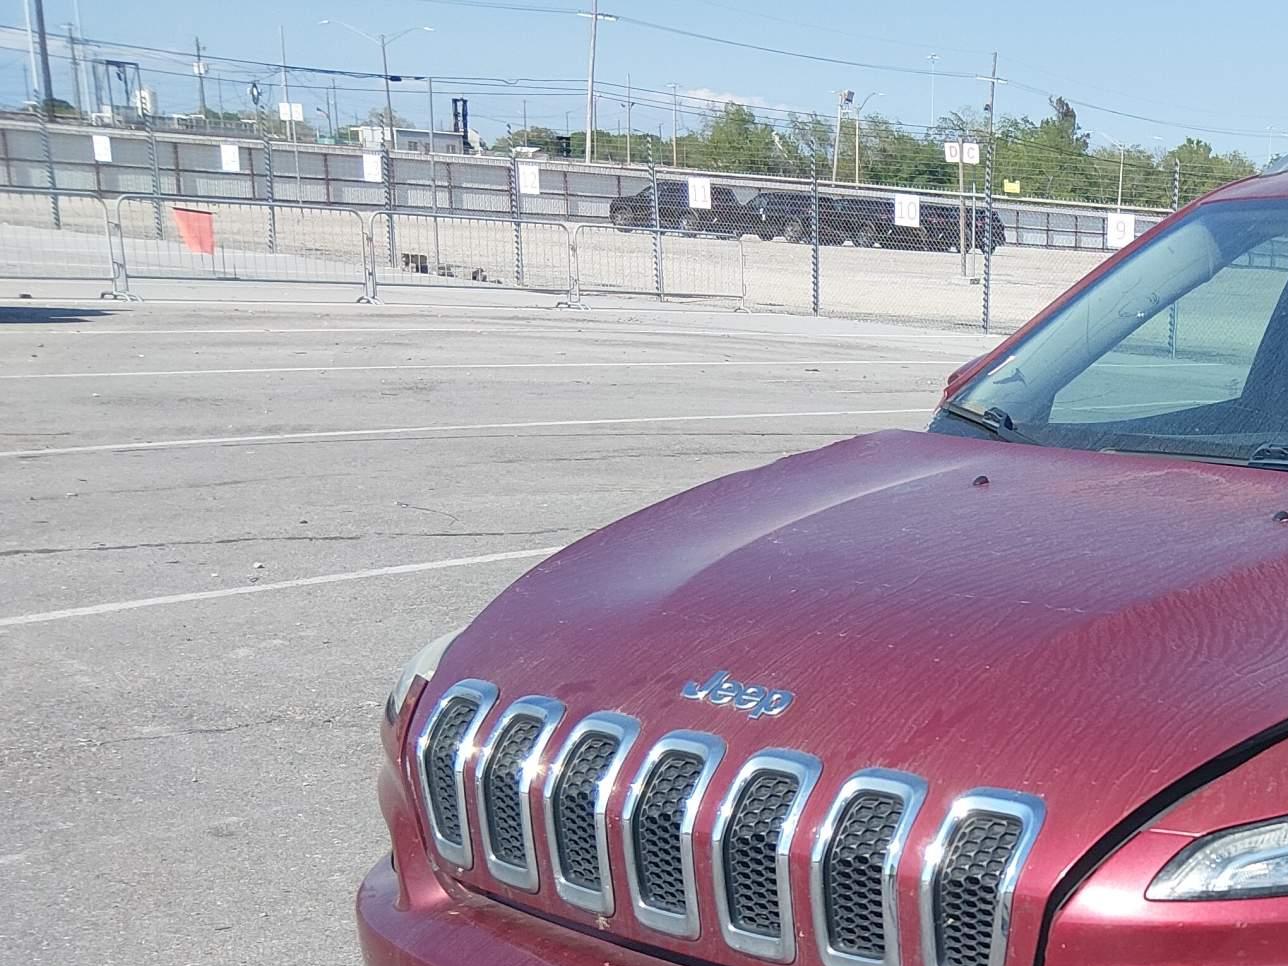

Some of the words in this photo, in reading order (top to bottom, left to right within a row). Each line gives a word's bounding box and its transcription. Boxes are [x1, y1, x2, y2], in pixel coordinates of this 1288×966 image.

[966, 146, 976, 159] C
[522, 171, 538, 190] 12
[691, 184, 708, 203] 11
[896, 200, 918, 221] 10
[1115, 220, 1127, 240] 9
[681, 670, 796, 720] Jeep
